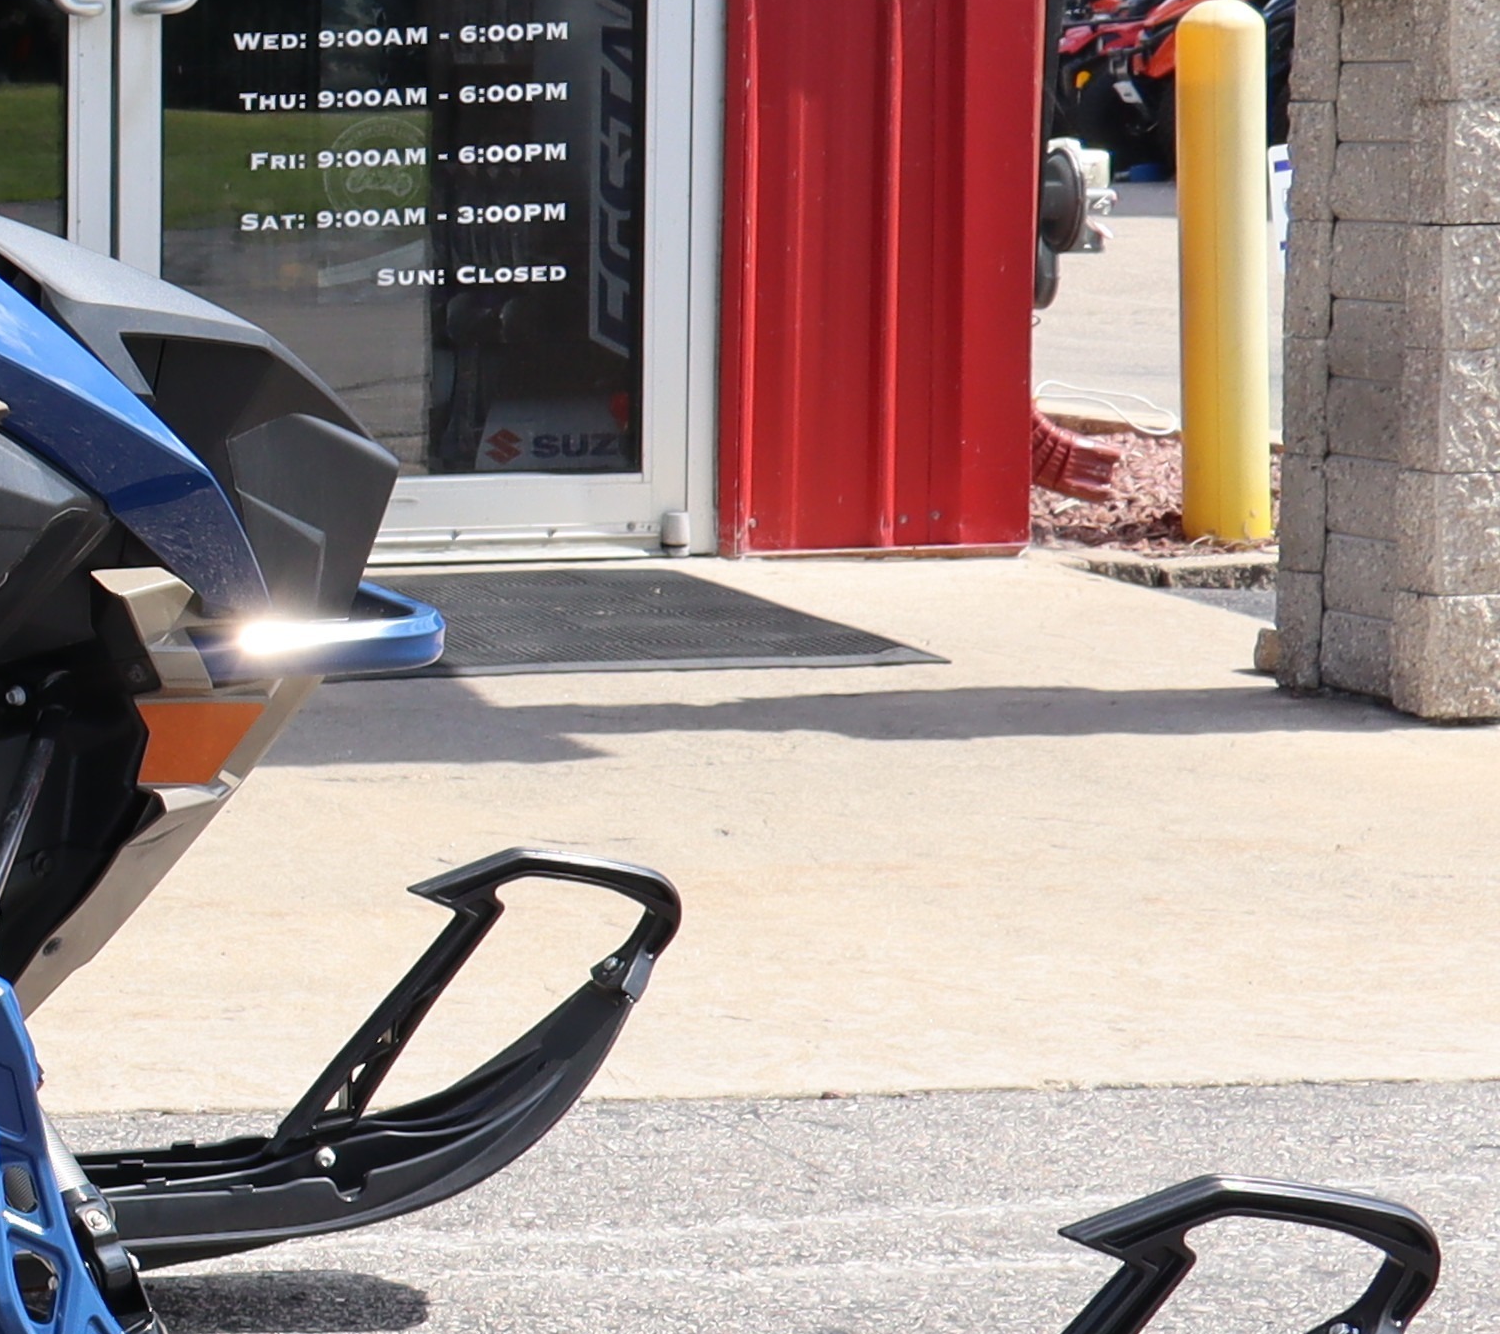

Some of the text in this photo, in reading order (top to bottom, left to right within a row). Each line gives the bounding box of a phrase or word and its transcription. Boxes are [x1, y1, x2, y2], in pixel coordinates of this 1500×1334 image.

[317, 26, 428, 48] 9:00AM
[459, 21, 569, 43] 6:00PM
[317, 86, 428, 108] 9:00AM
[458, 82, 568, 104] 6:00PM
[317, 147, 427, 169] 9:00AM
[457, 142, 567, 164] 6:00PM
[316, 207, 426, 229] 9:00AM
[456, 202, 566, 225] 3:00PM
